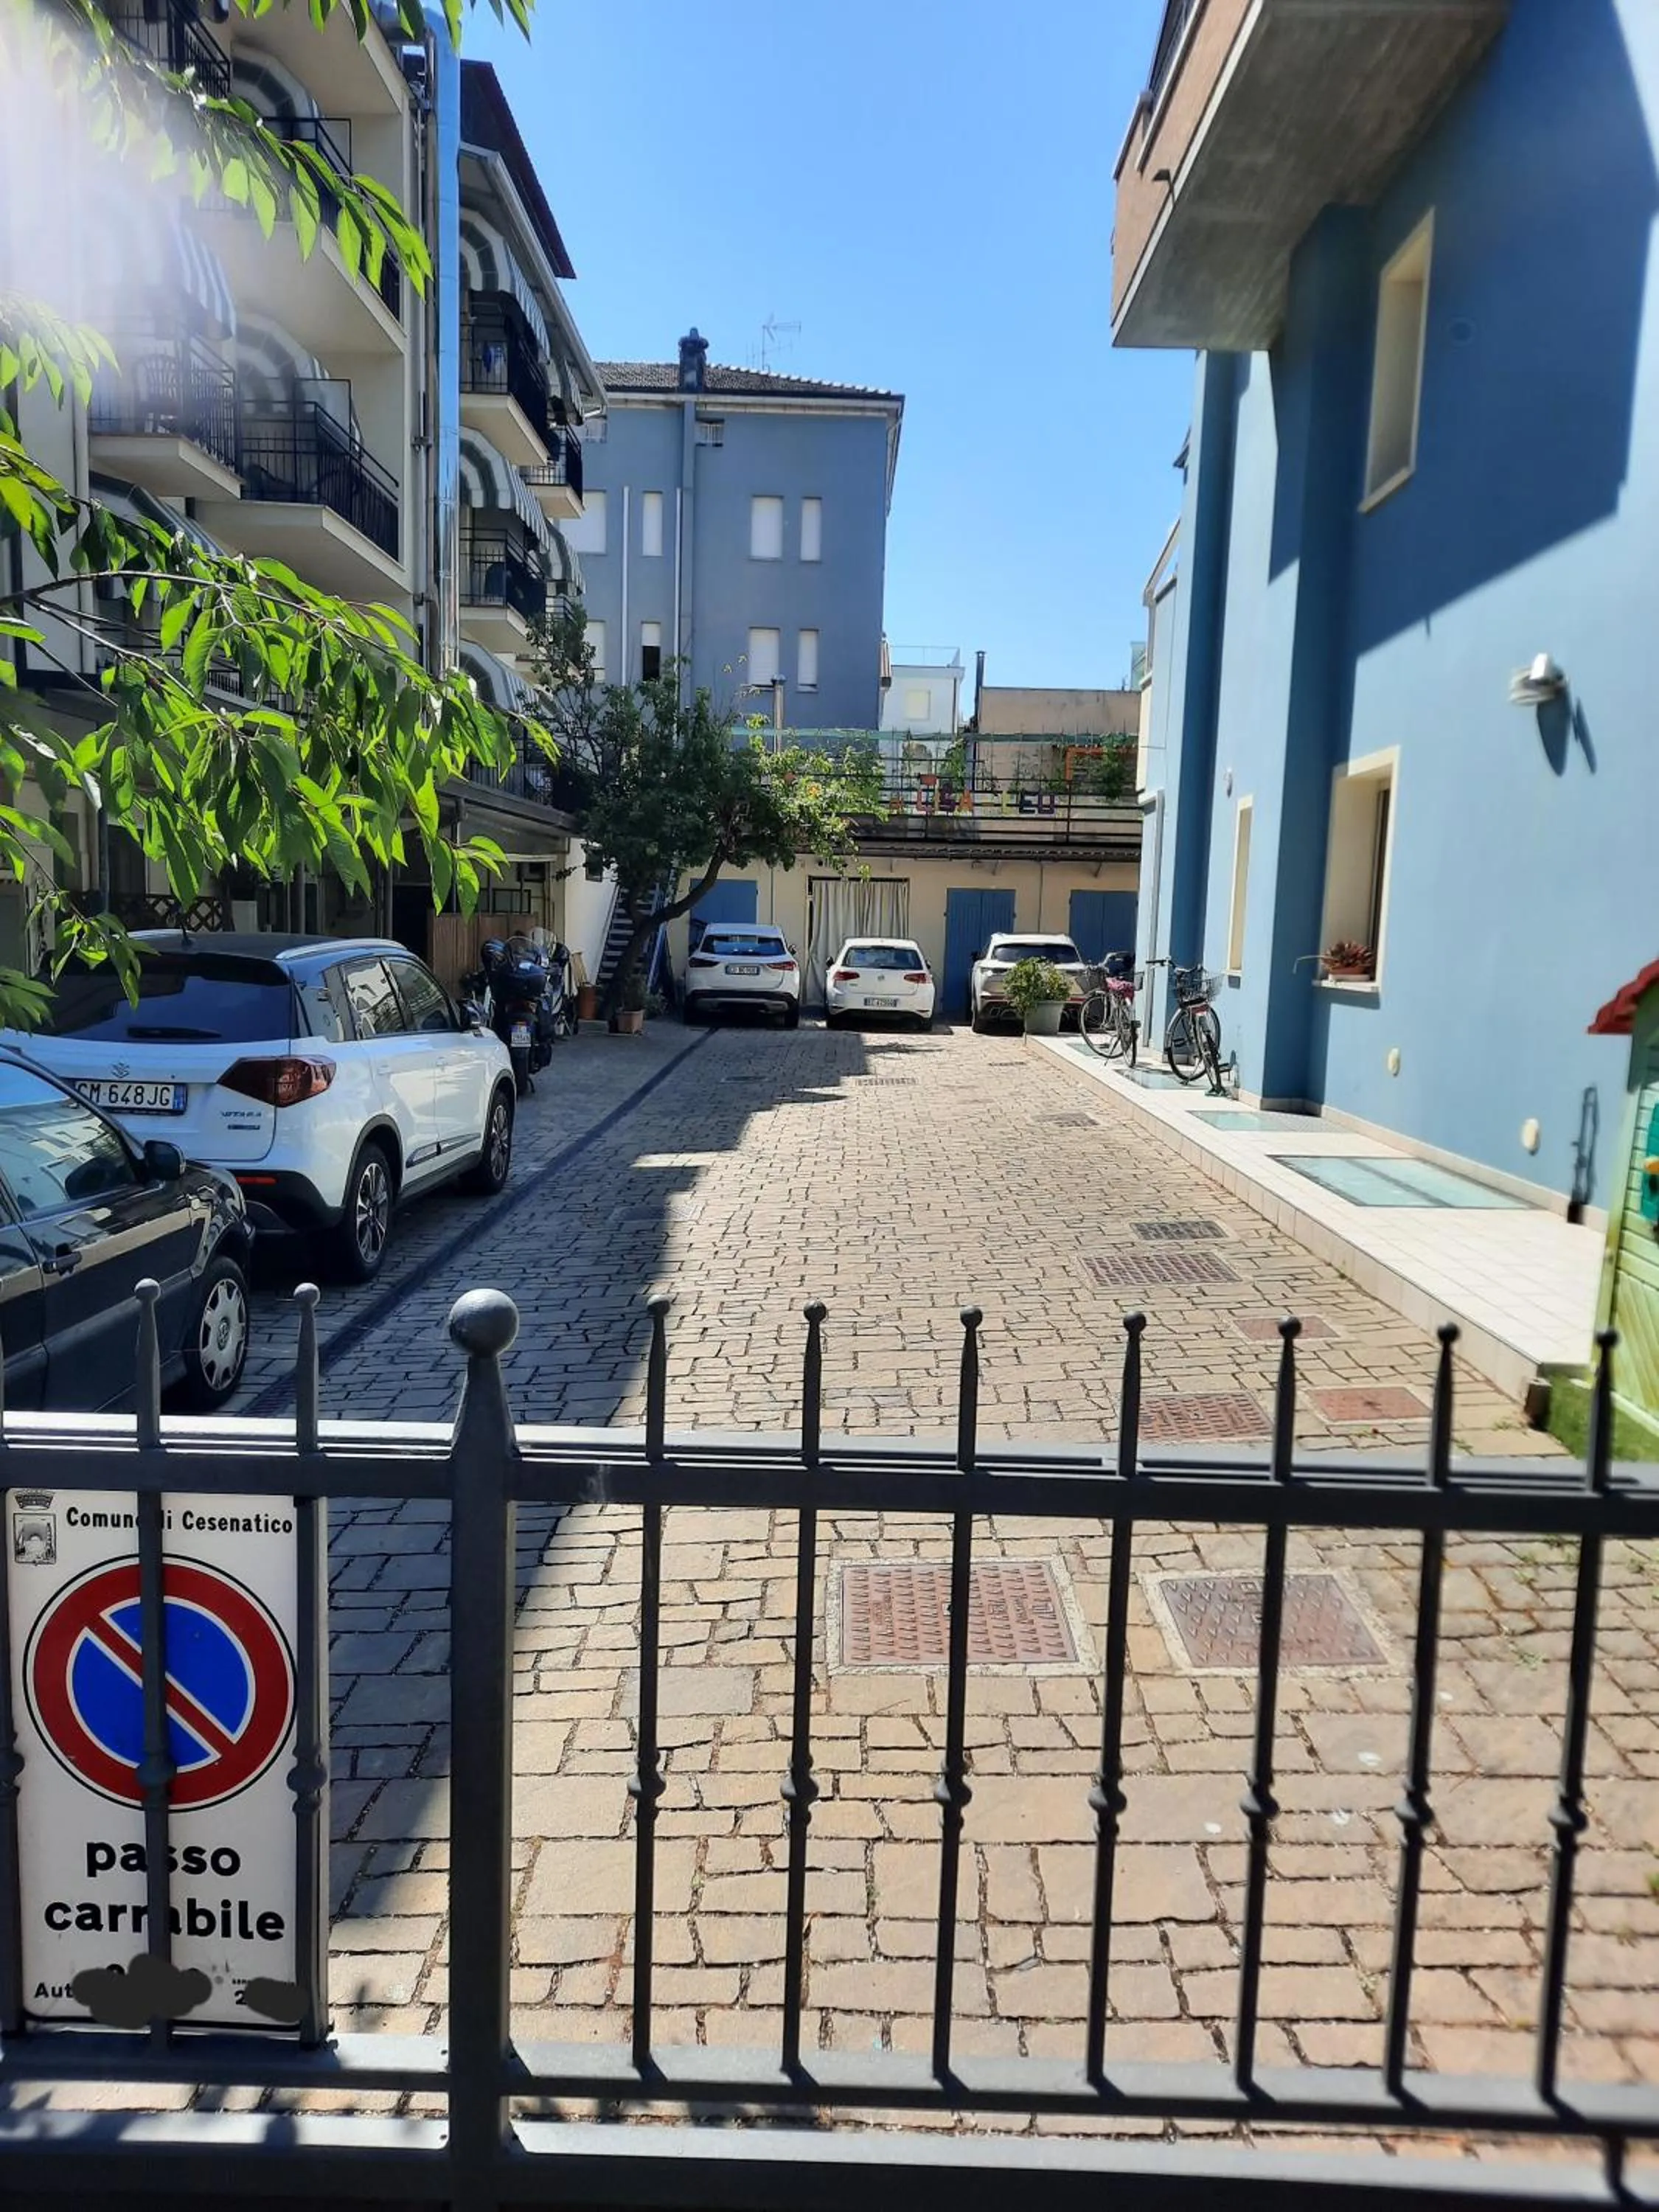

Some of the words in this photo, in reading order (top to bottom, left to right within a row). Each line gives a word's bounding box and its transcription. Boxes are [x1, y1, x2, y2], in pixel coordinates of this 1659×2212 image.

[108, 1084, 170, 1106] 648JG
[66, 1507, 140, 1529] Comun
[182, 1510, 293, 1534] Cesenatico
